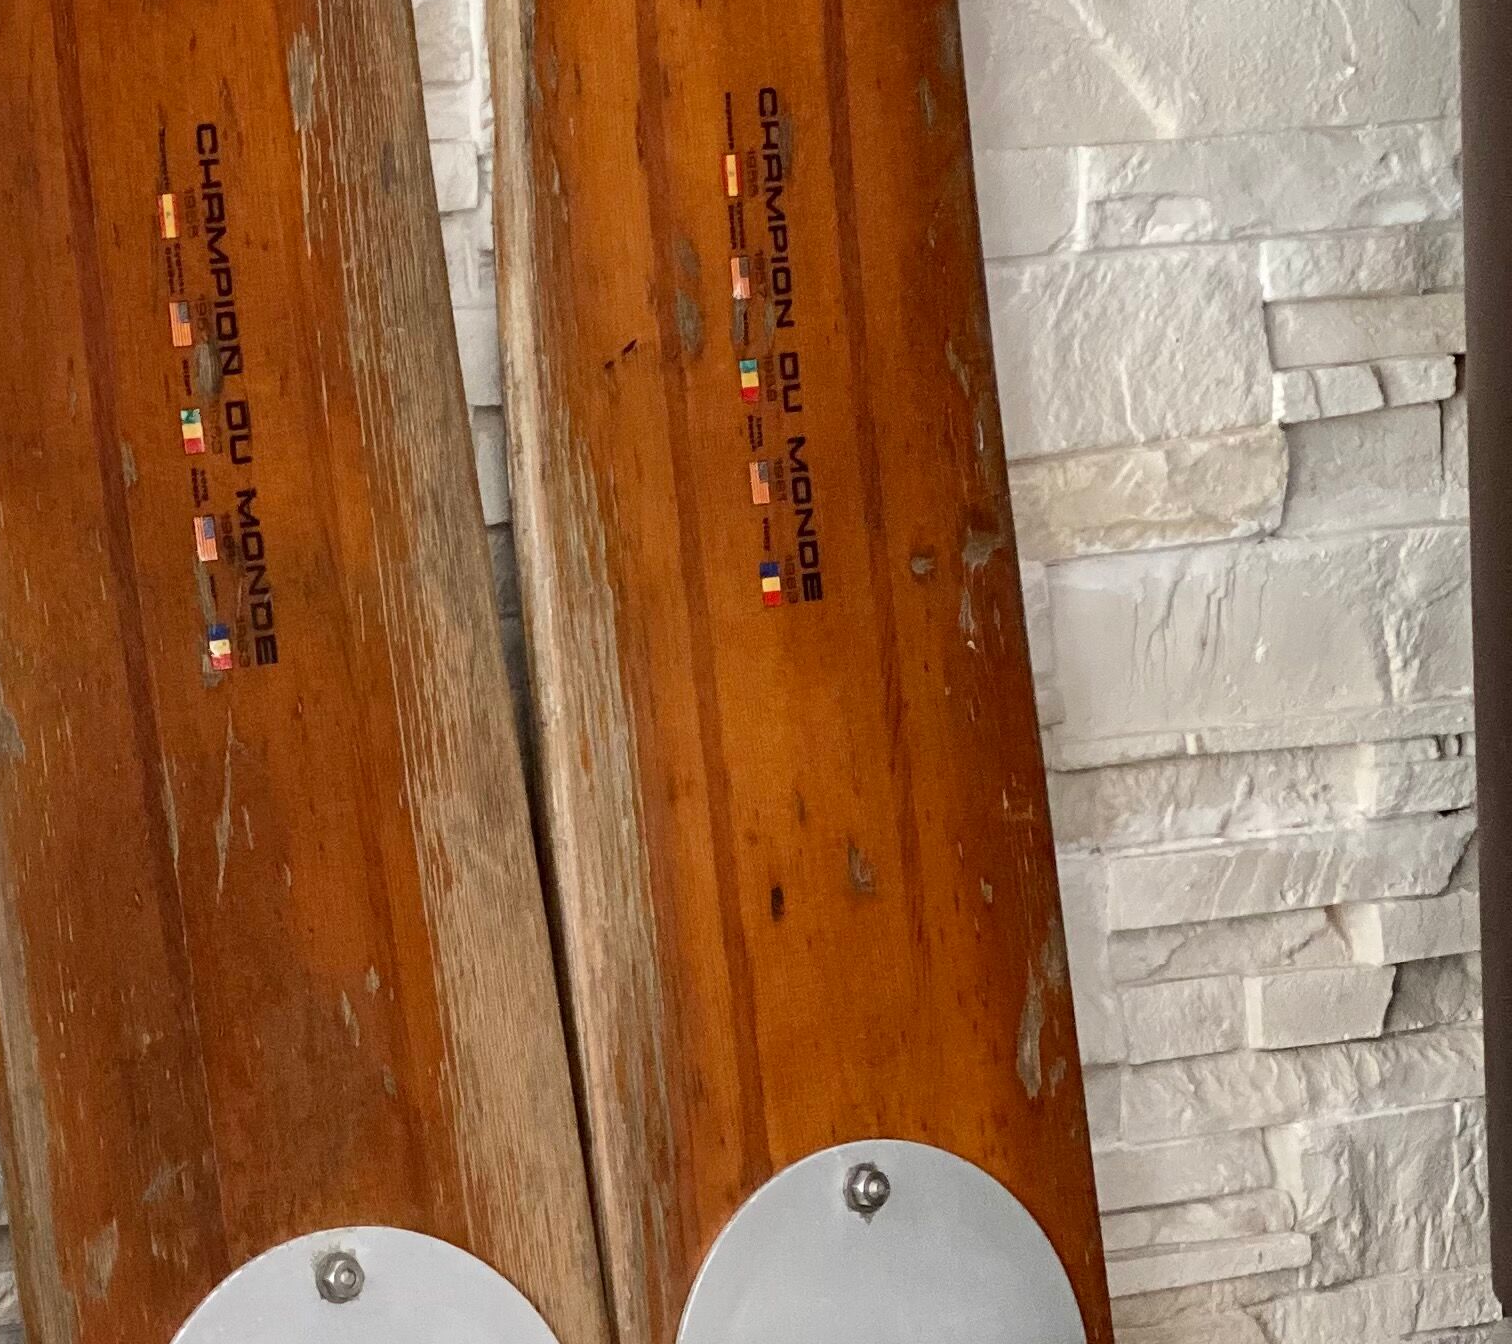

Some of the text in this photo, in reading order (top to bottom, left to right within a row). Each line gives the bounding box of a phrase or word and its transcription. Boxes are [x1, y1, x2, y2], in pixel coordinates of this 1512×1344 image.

[196, 123, 279, 666] CHAMPION DU MONDE
[759, 86, 824, 603] CHAMPION DU MONDE
